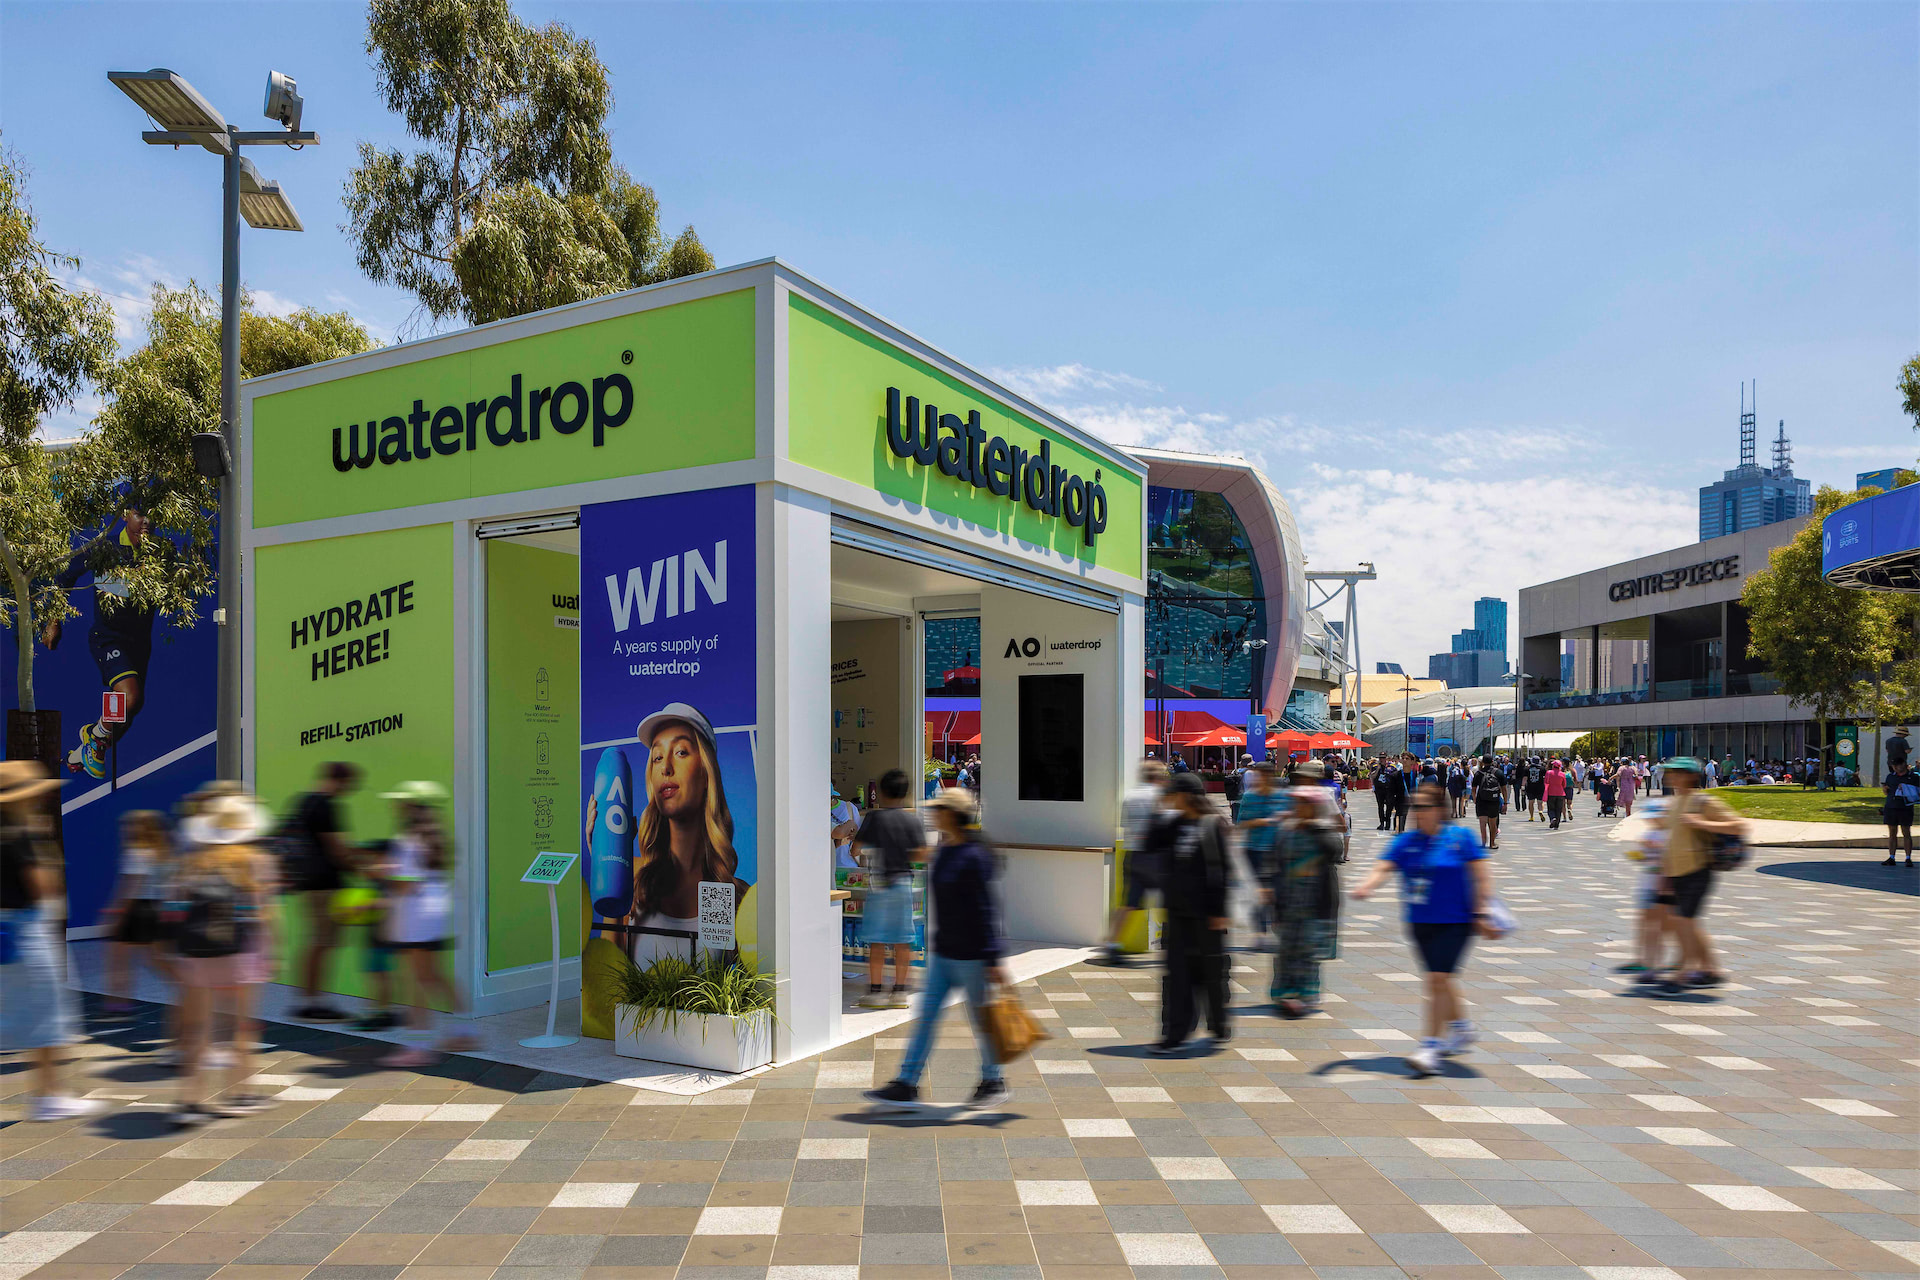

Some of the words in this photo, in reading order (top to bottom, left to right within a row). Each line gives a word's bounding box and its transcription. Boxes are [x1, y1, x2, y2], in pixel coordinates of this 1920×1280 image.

[604, 539, 728, 633] WIN
[1608, 554, 1740, 603] CENTREPIECE
[290, 580, 414, 650] HYDRATE
[311, 628, 390, 682] HERE!
[612, 640, 623, 655] A
[625, 641, 658, 658] years
[660, 635, 702, 655] supply
[705, 634, 719, 650] of
[1003, 637, 1041, 659] AO
[831, 658, 858, 672] RICES
[300, 721, 344, 747] REFILL
[344, 712, 403, 743] STATION
[535, 832, 551, 840] Enjoy
[532, 867, 561, 877] ONLY
[541, 859, 568, 868] EXIT
[701, 926, 717, 935] SCAN
[717, 928, 733, 936] HERE
